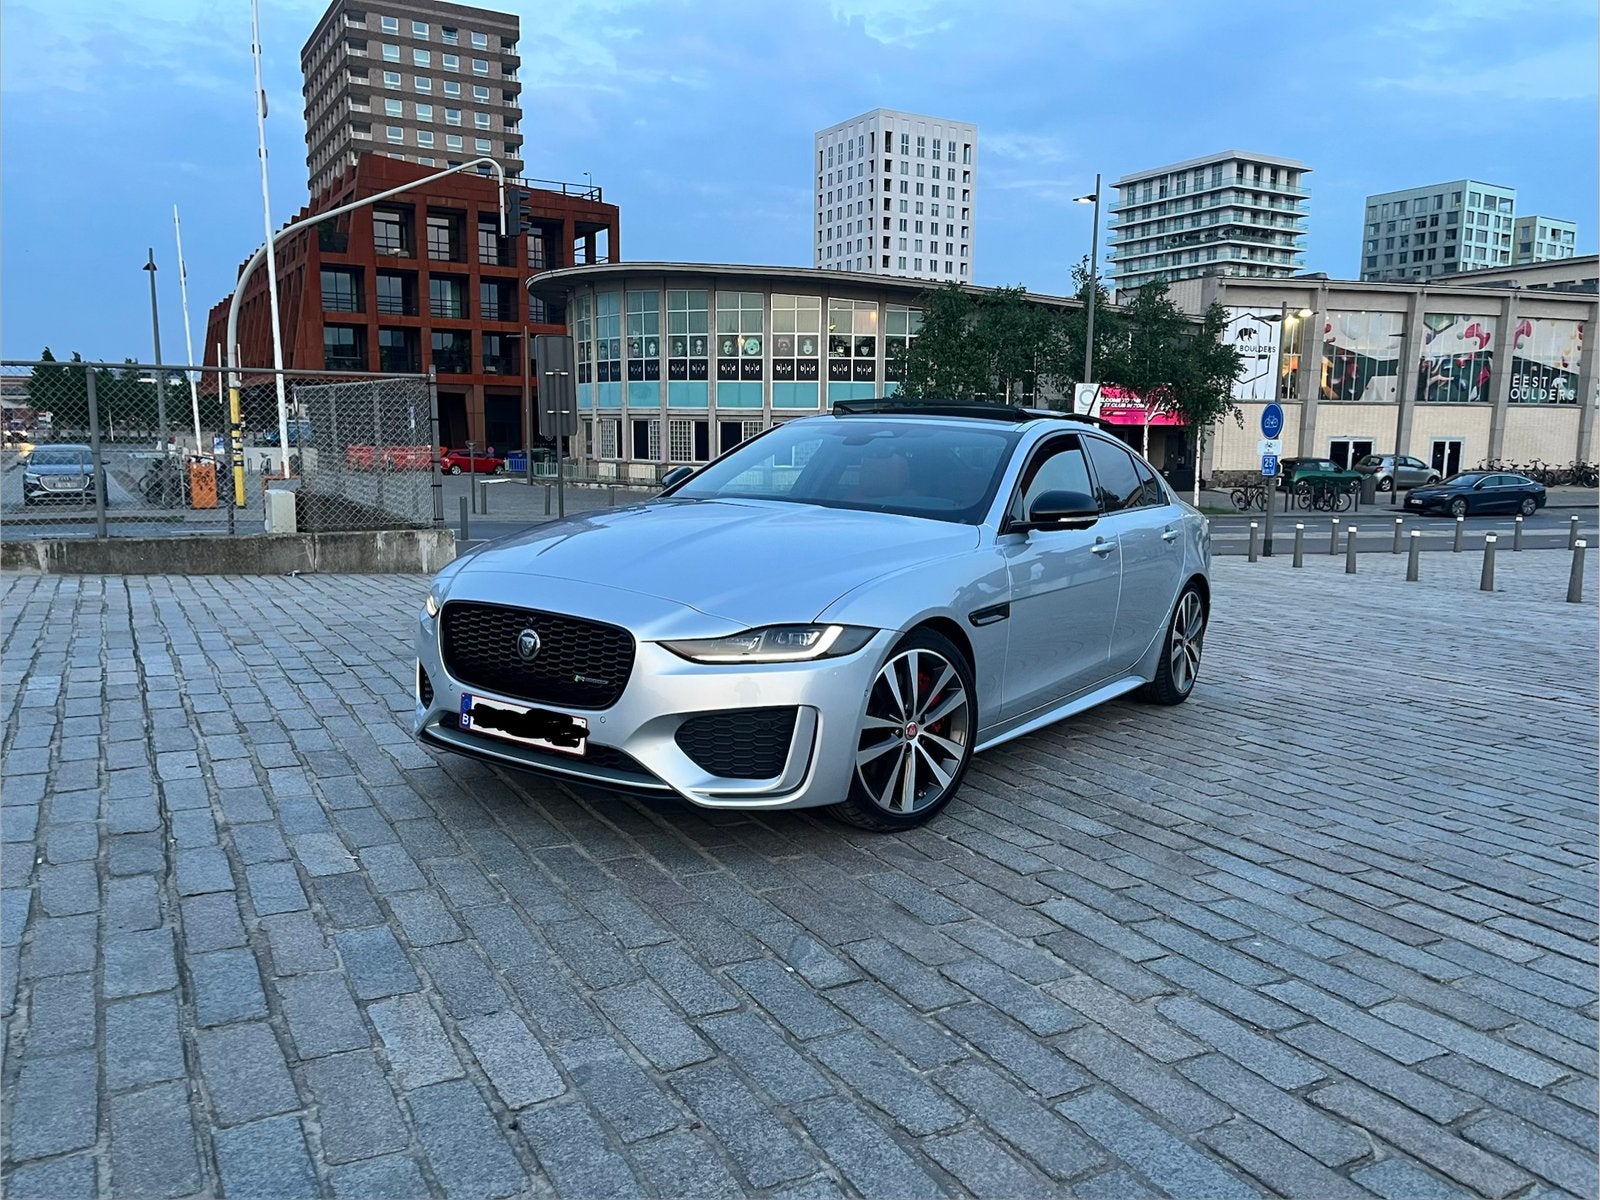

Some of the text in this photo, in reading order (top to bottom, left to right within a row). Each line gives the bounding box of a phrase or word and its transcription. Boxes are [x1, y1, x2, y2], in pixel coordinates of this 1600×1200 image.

[1239, 345, 1276, 353] BOULDERS
[1512, 375, 1549, 388] EEST
[1510, 388, 1575, 400] OULDERS
[1264, 458, 1274, 468] 25
[462, 713, 469, 725] B
